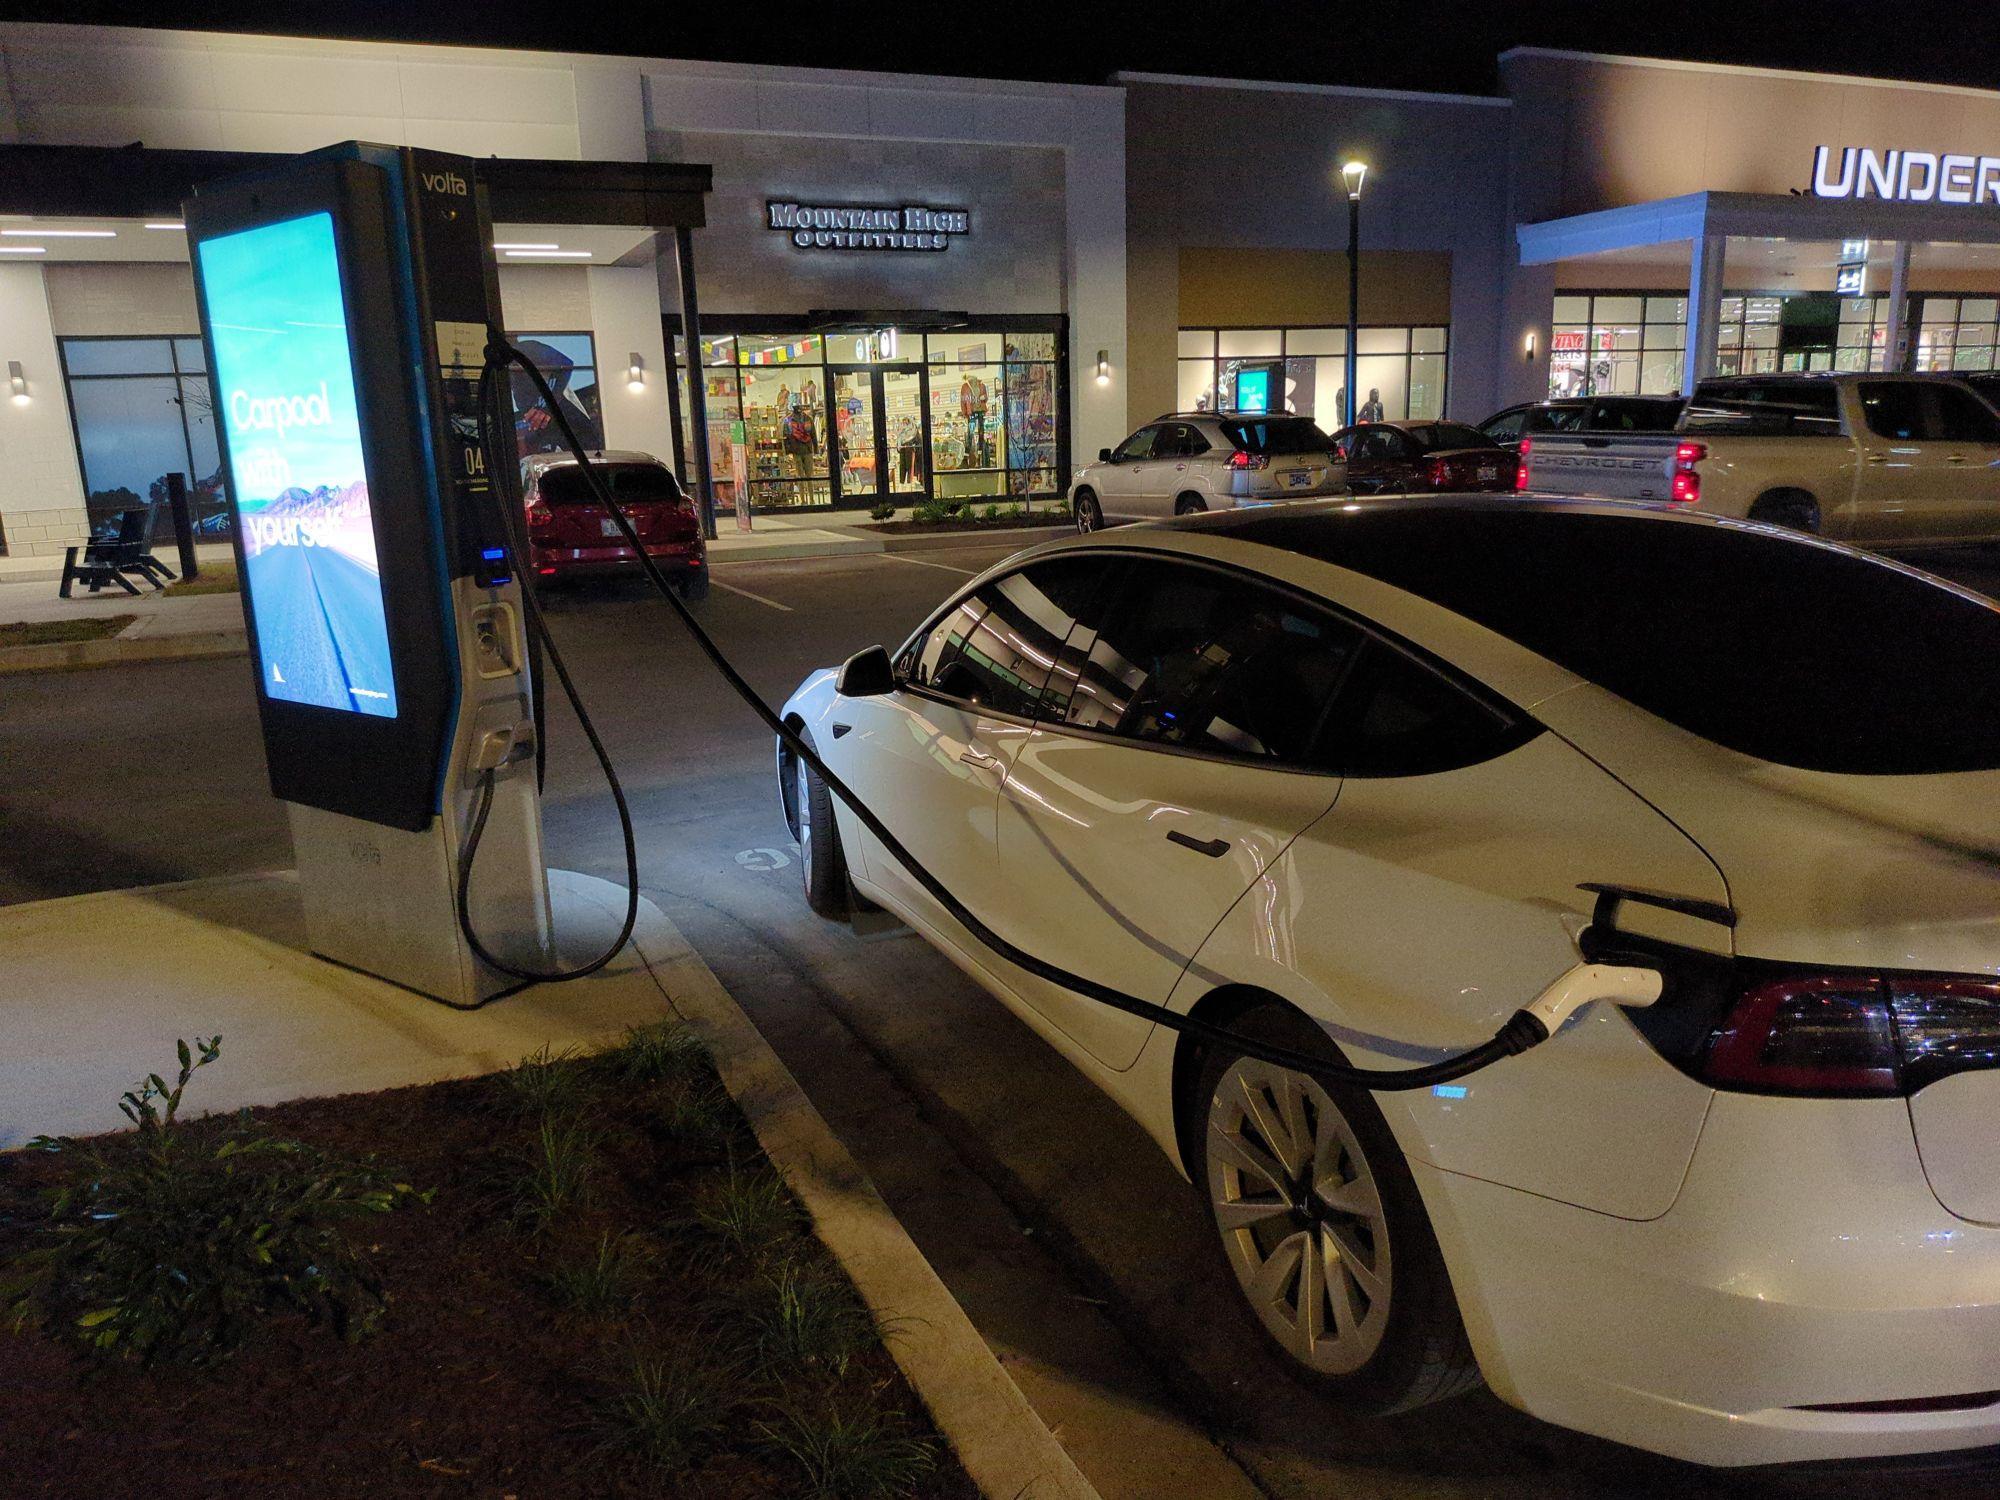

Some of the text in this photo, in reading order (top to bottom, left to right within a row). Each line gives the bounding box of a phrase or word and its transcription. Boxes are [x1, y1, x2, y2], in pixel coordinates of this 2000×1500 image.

[422, 171, 467, 196] volta
[1811, 145, 2000, 205] UNDER
[770, 203, 968, 231] MOUNTAIN HIGH
[795, 231, 948, 248] OUTFITTERS
[230, 381, 332, 439] Carpool
[239, 448, 292, 488] with
[465, 447, 484, 475] 04
[1534, 456, 1660, 469] CHEVROLET
